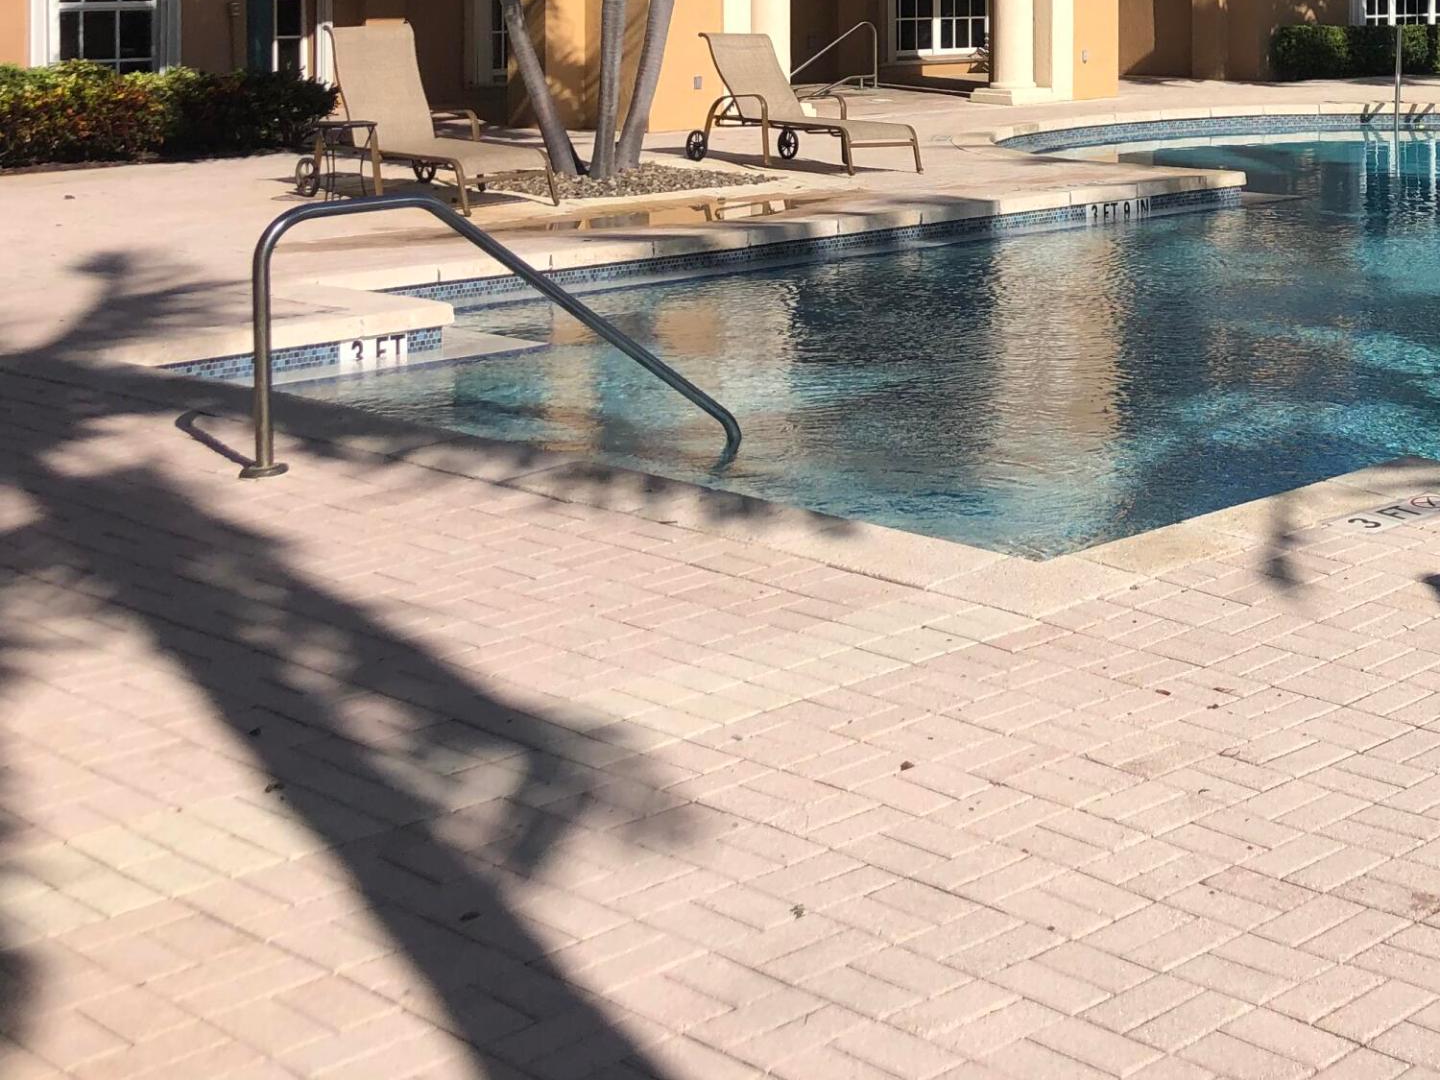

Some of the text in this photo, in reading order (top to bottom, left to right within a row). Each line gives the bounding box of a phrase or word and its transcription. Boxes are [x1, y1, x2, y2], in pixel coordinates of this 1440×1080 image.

[1104, 202, 1118, 220] FT
[1136, 198, 1149, 217] IN
[351, 334, 406, 361] 3 FT
[1348, 505, 1421, 529] 3 FT
